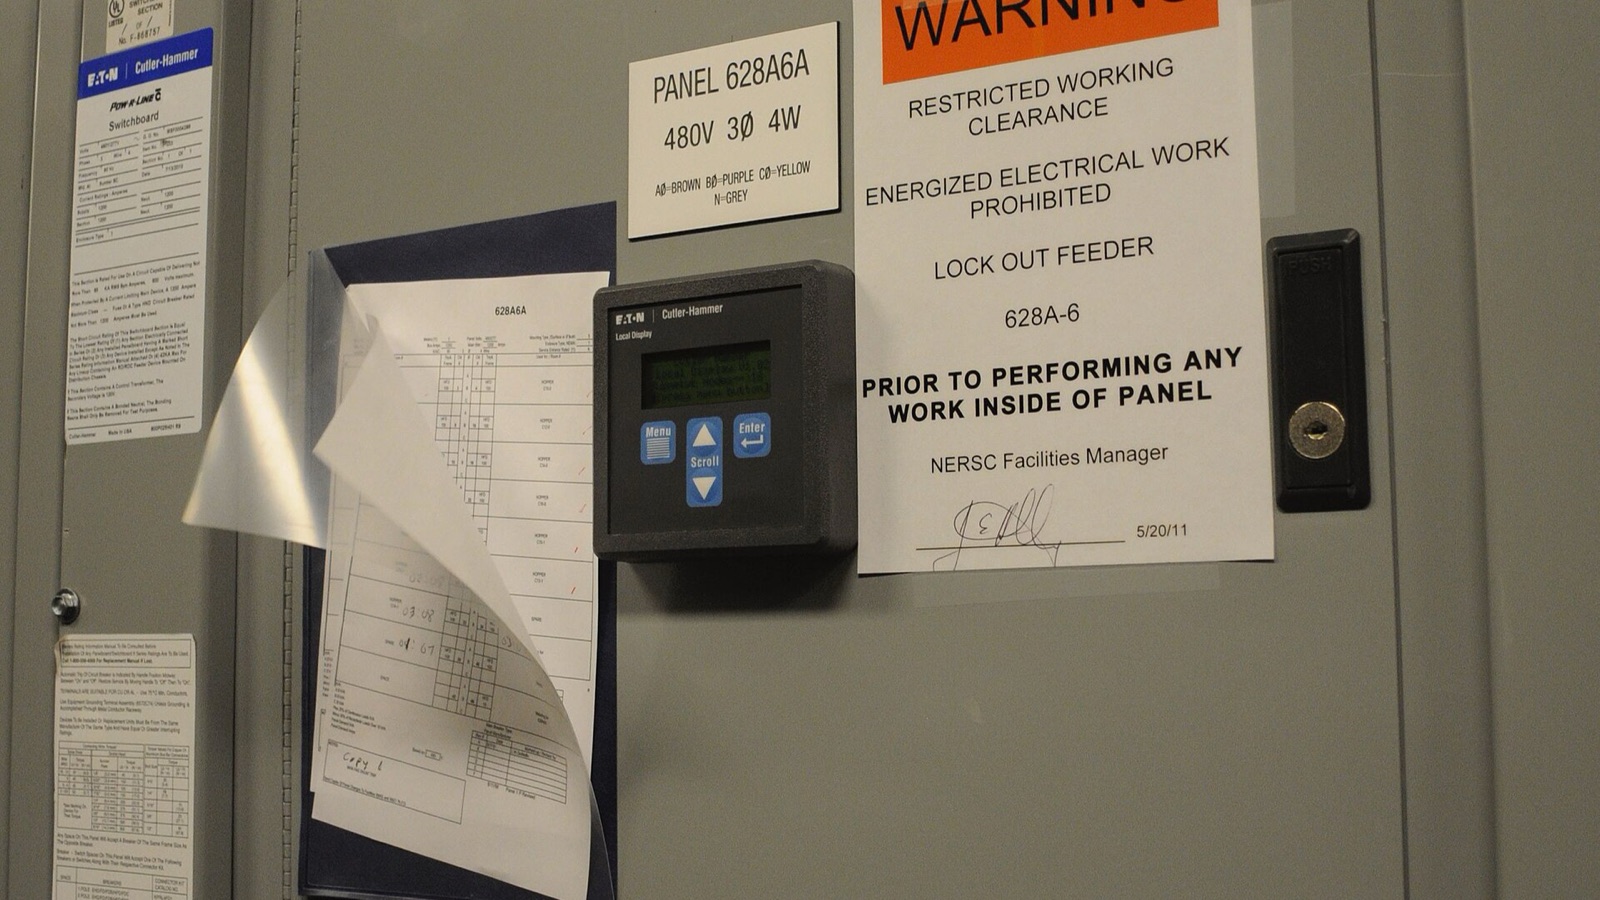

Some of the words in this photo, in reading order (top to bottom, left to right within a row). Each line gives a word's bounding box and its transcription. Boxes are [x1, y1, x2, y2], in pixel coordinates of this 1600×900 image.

[138, 2, 163, 15] SECTION
[108, 18, 124, 28] LISTED
[895, 0, 1201, 51] WARN
[135, 48, 198, 75] Cutler-Hammer
[653, 67, 719, 104] PANEL
[725, 48, 810, 90] 628A6A
[909, 78, 1050, 119] RESTRICTED
[1057, 57, 1174, 94] WORKING
[109, 111, 160, 132] Switchboard
[664, 120, 715, 150] 480V
[768, 104, 801, 133] 4W
[968, 96, 1109, 136] CLEARANCE
[865, 171, 993, 206] ENERGIZED
[1000, 150, 1144, 188] ELECTRICAL
[1151, 137, 1231, 166] WORK
[714, 189, 748, 206] N=GREY
[970, 183, 1112, 219] PROHIBITED
[934, 255, 994, 280] LOCK
[1001, 248, 1050, 272] OUT
[1057, 236, 1154, 266] FEEDER
[495, 305, 527, 316] 628A6A
[662, 304, 724, 320] Cutler-Hammer
[1004, 302, 1081, 329] 628A-6
[616, 331, 630, 341] Local
[631, 329, 652, 341] Display
[862, 373, 938, 398] PRIOR
[947, 370, 982, 391] TO
[991, 352, 1172, 388] PERFORMING
[1183, 346, 1243, 373] ANY
[887, 399, 965, 424] WORK
[974, 391, 1061, 417] INSIDE
[1071, 387, 1108, 410] OF
[1118, 380, 1212, 406] PANEL
[646, 426, 671, 438] Menu
[739, 422, 765, 434] Enter
[690, 456, 719, 469] Scroll
[930, 453, 997, 474] NERSC
[1002, 447, 1080, 470] Facilities
[1085, 445, 1168, 470] Manager
[1136, 523, 1188, 539] 5/20/11
